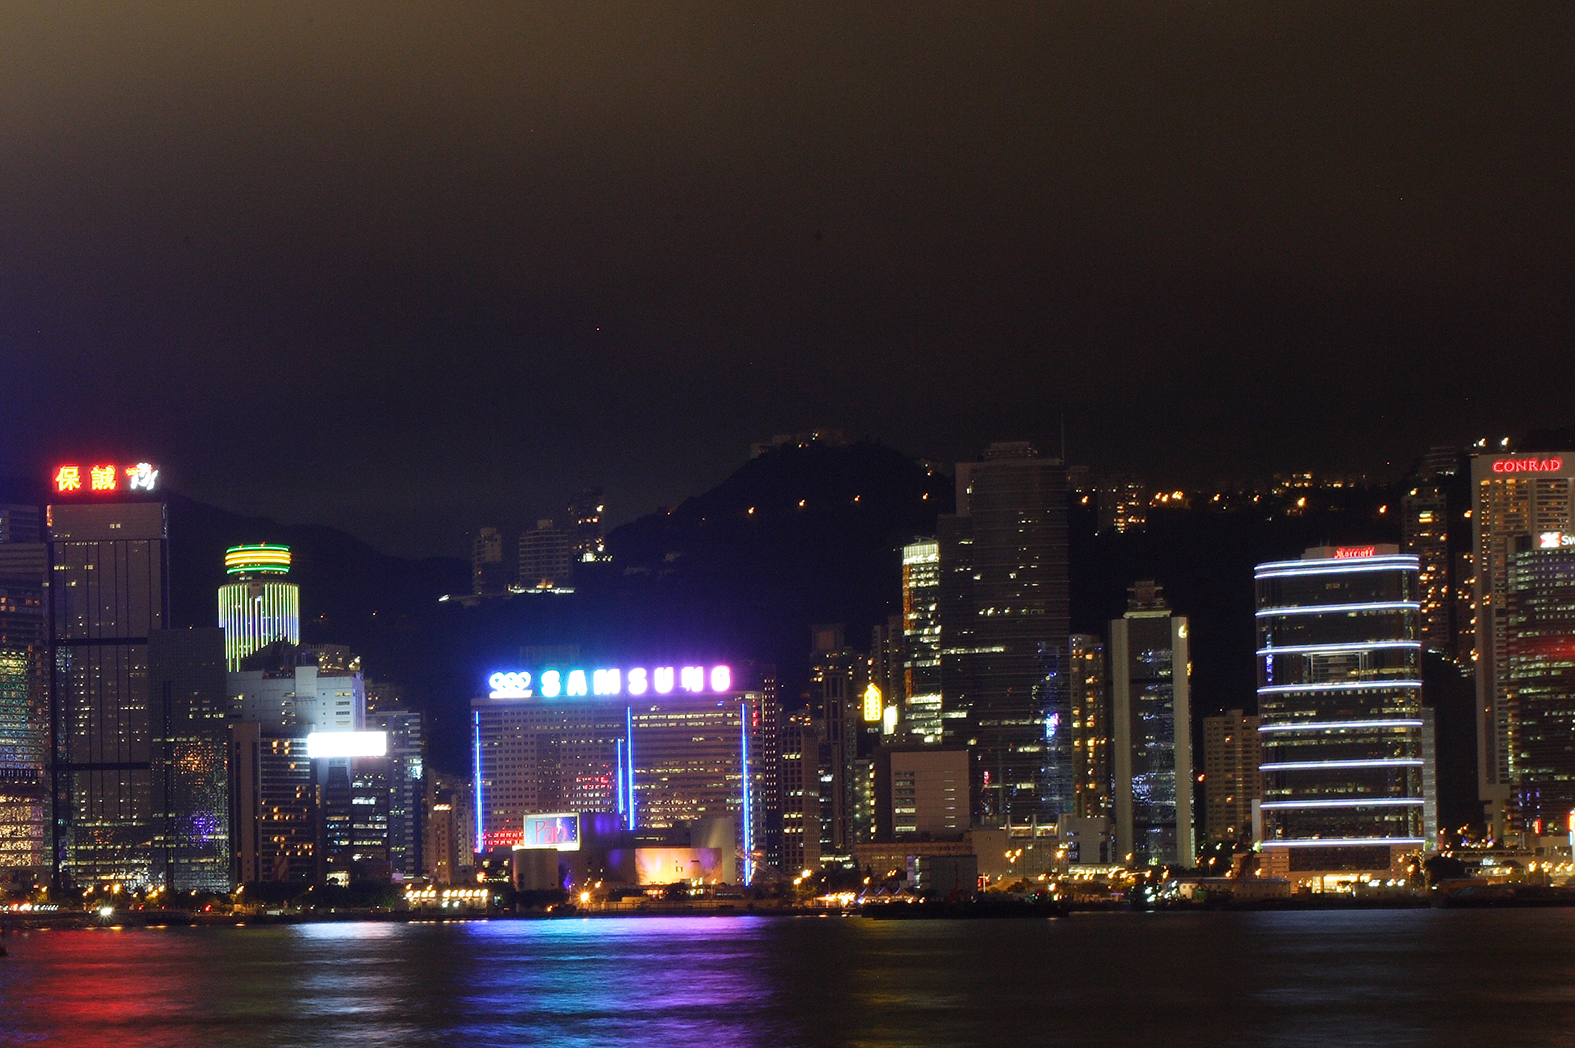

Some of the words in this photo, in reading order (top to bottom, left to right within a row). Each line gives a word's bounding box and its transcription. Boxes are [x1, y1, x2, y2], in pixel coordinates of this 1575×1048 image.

[1492, 457, 1562, 473] CONRAD
[1334, 547, 1374, 559] Marriott
[541, 665, 731, 697] SAMSUNG
